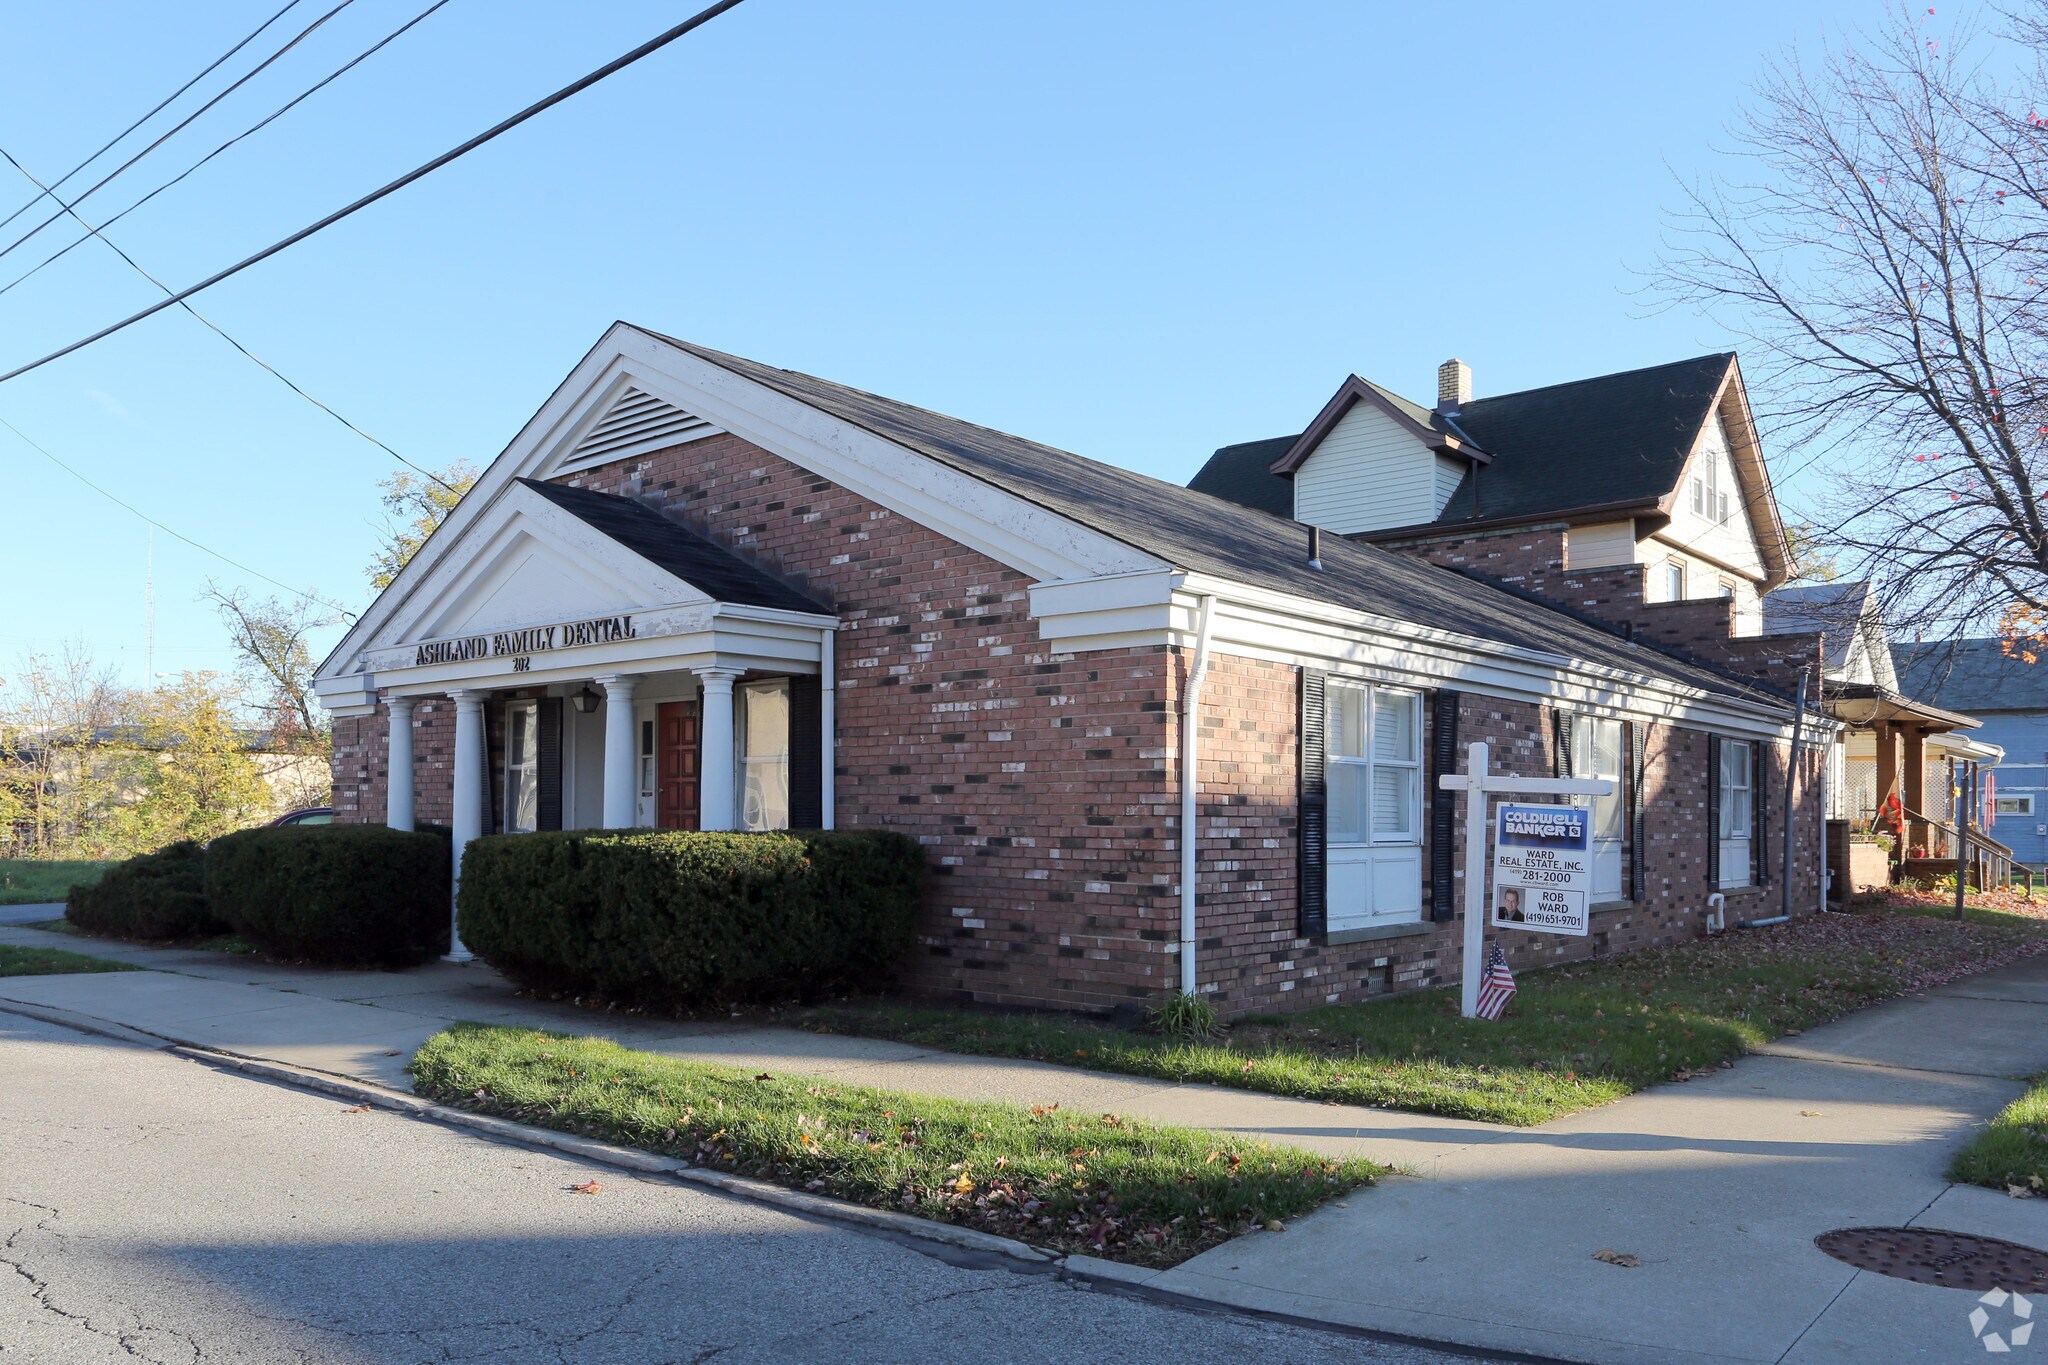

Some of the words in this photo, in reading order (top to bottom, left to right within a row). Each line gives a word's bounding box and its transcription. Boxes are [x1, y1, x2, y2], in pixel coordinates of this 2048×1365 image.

[416, 638, 487, 665] ASHLAND
[493, 626, 556, 656] FAMILY
[562, 615, 635, 647] DENTAL
[512, 656, 530, 672] 202
[1505, 811, 1582, 826] COLDWELL
[1505, 822, 1566, 837] BANKER
[1526, 850, 1555, 860] WARD
[1500, 856, 1522, 866] REAL
[1525, 858, 1562, 870] ESTATE,
[1564, 861, 1584, 871] INC.
[1522, 870, 1571, 883] 281-2000
[1542, 891, 1564, 902] ROB
[1538, 902, 1569, 914] WARD
